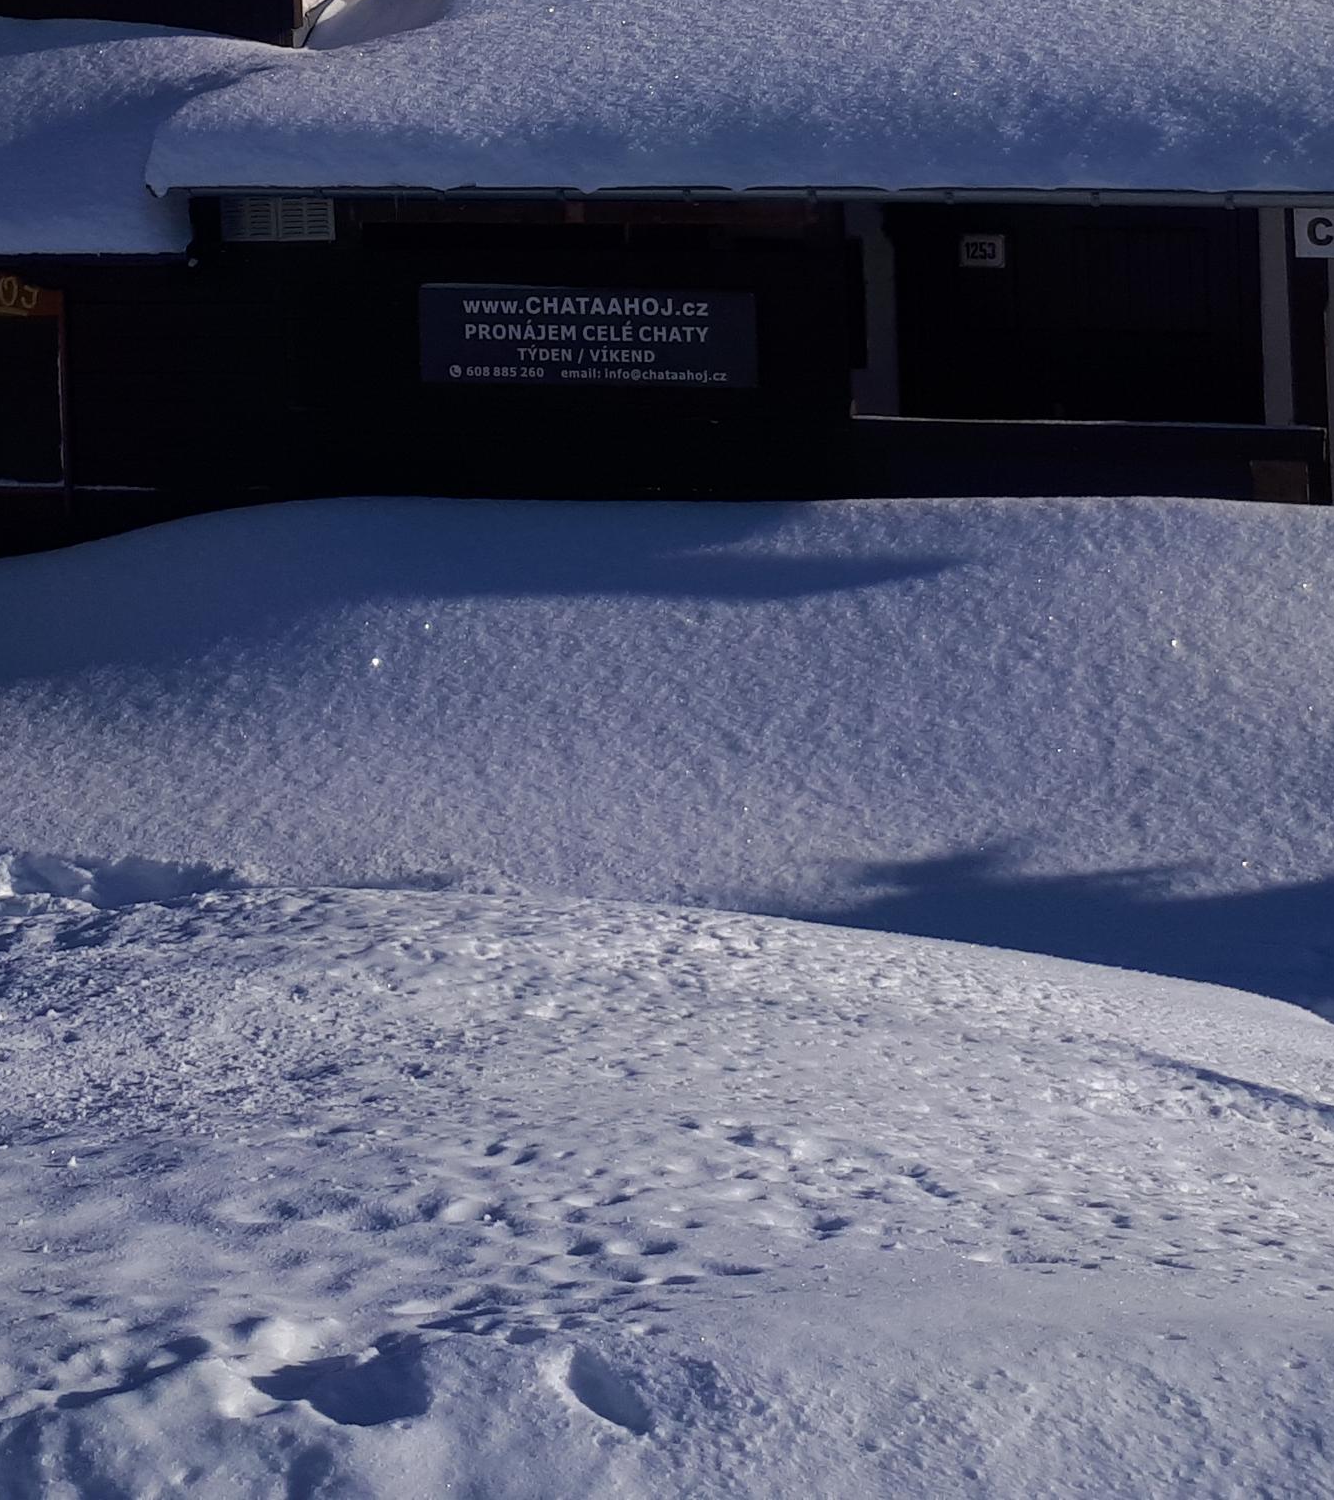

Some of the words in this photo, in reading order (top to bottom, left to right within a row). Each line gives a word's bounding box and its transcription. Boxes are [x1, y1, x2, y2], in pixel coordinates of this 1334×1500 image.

[965, 242, 996, 260] 1253
[462, 296, 709, 317] www.CHATAAHOJ.cz
[464, 318, 577, 341] PRONÁJEM
[582, 320, 634, 342] CELÉ
[638, 325, 709, 343] CHATY
[516, 344, 573, 362] TÝDEN
[577, 347, 585, 365] /
[589, 345, 656, 363] VÍKEND
[466, 366, 491, 378] 608
[492, 366, 518, 378] 885
[519, 366, 545, 378] 260
[560, 367, 602, 380] email:
[604, 367, 728, 384] info@chataahoj.cz
